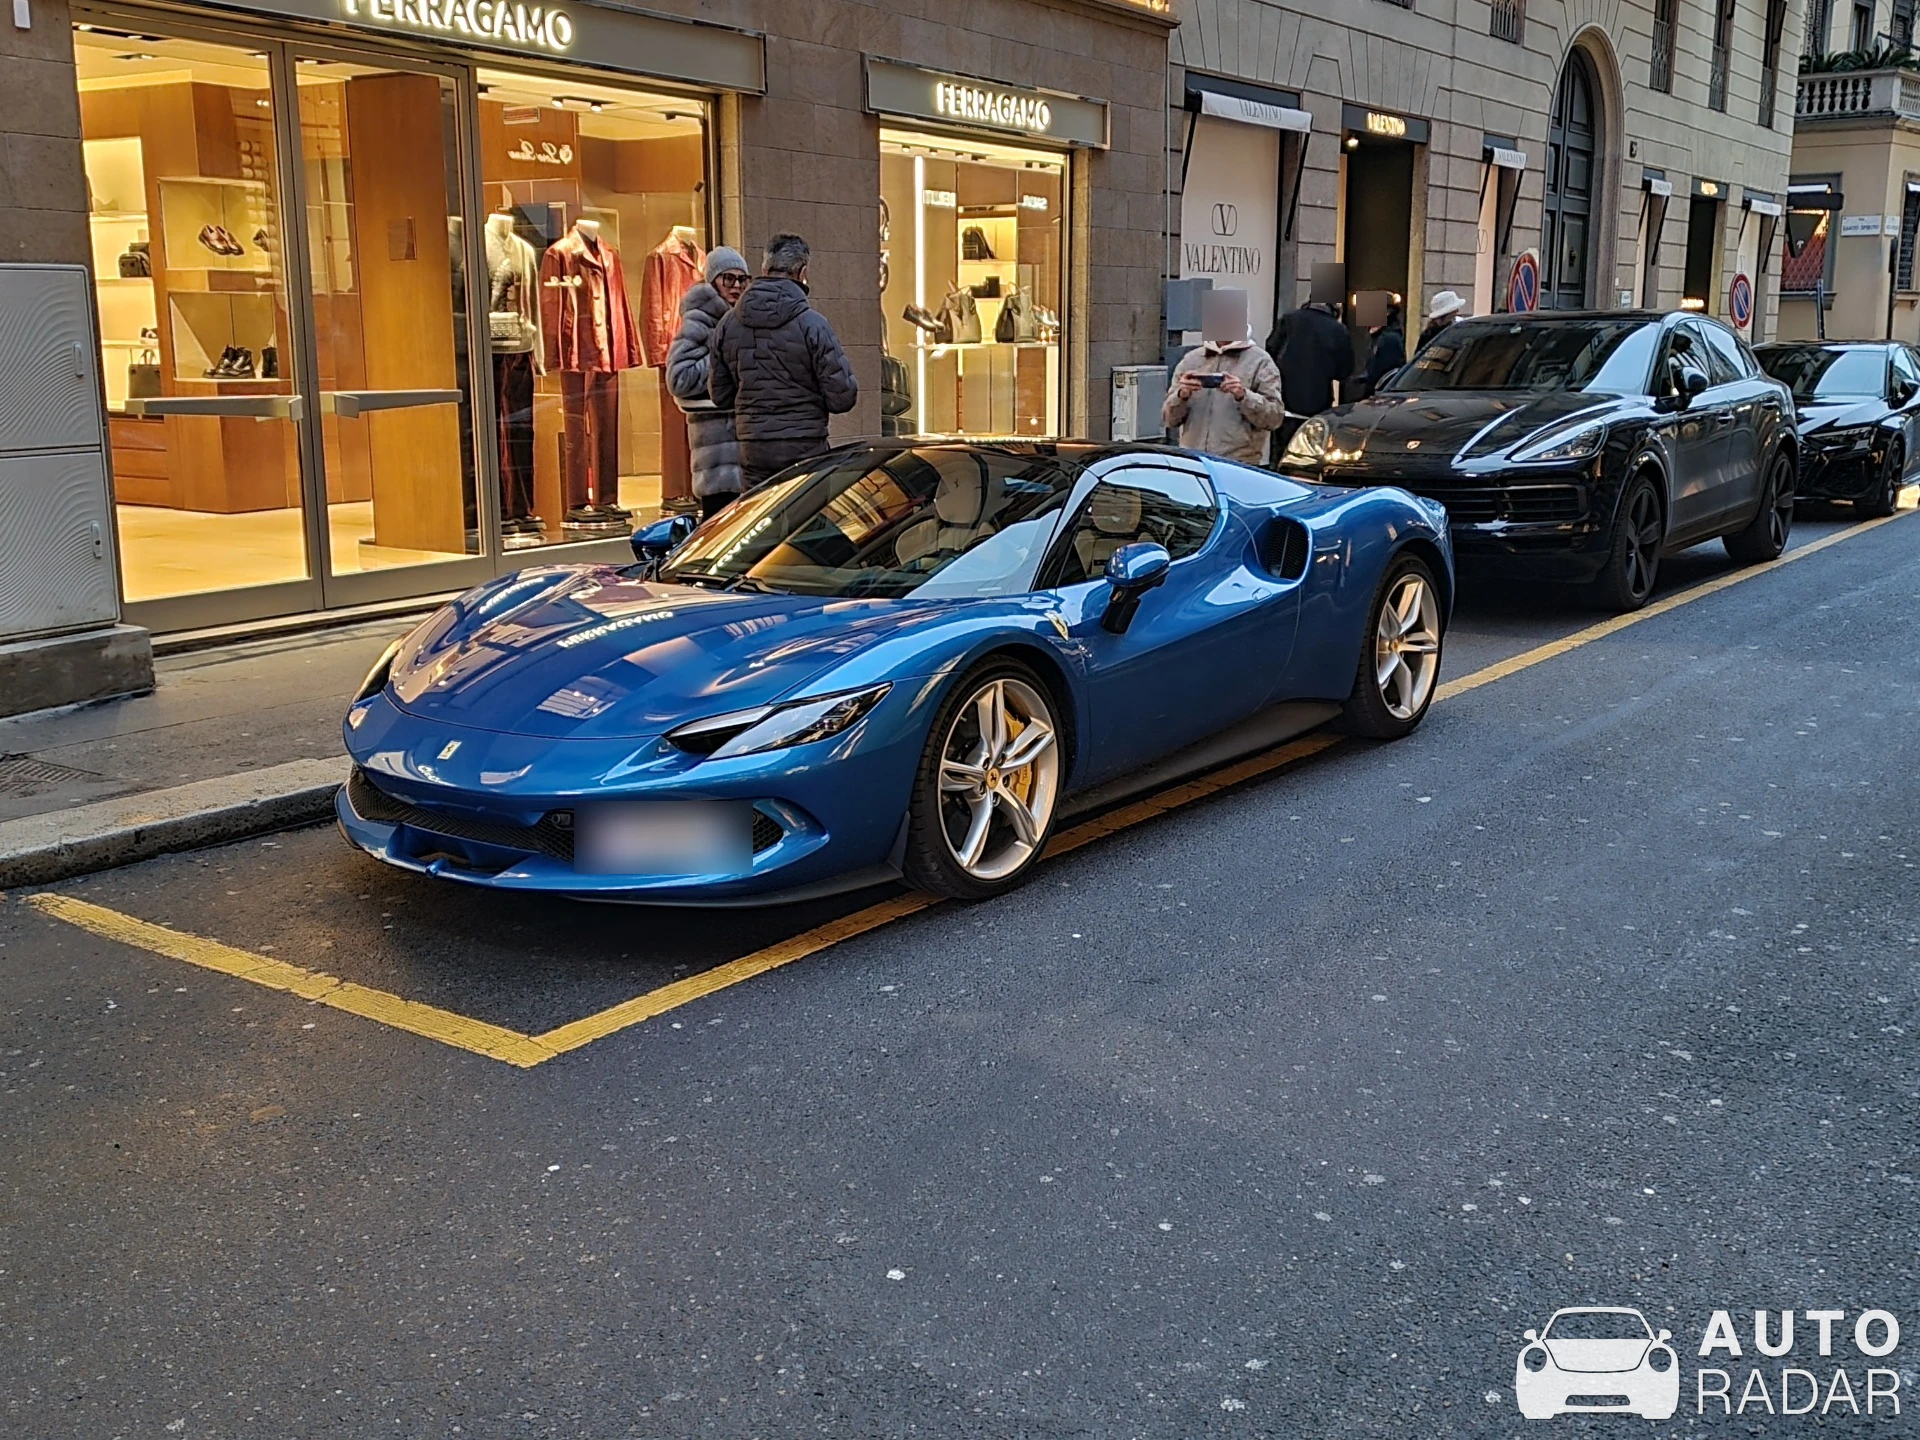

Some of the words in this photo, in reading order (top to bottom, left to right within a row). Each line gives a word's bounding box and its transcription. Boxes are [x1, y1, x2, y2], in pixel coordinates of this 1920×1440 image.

[936, 82, 1051, 131] FERRAGAMO
[1239, 99, 1282, 121] VALENTINO
[1185, 243, 1261, 275] VALENTINO
